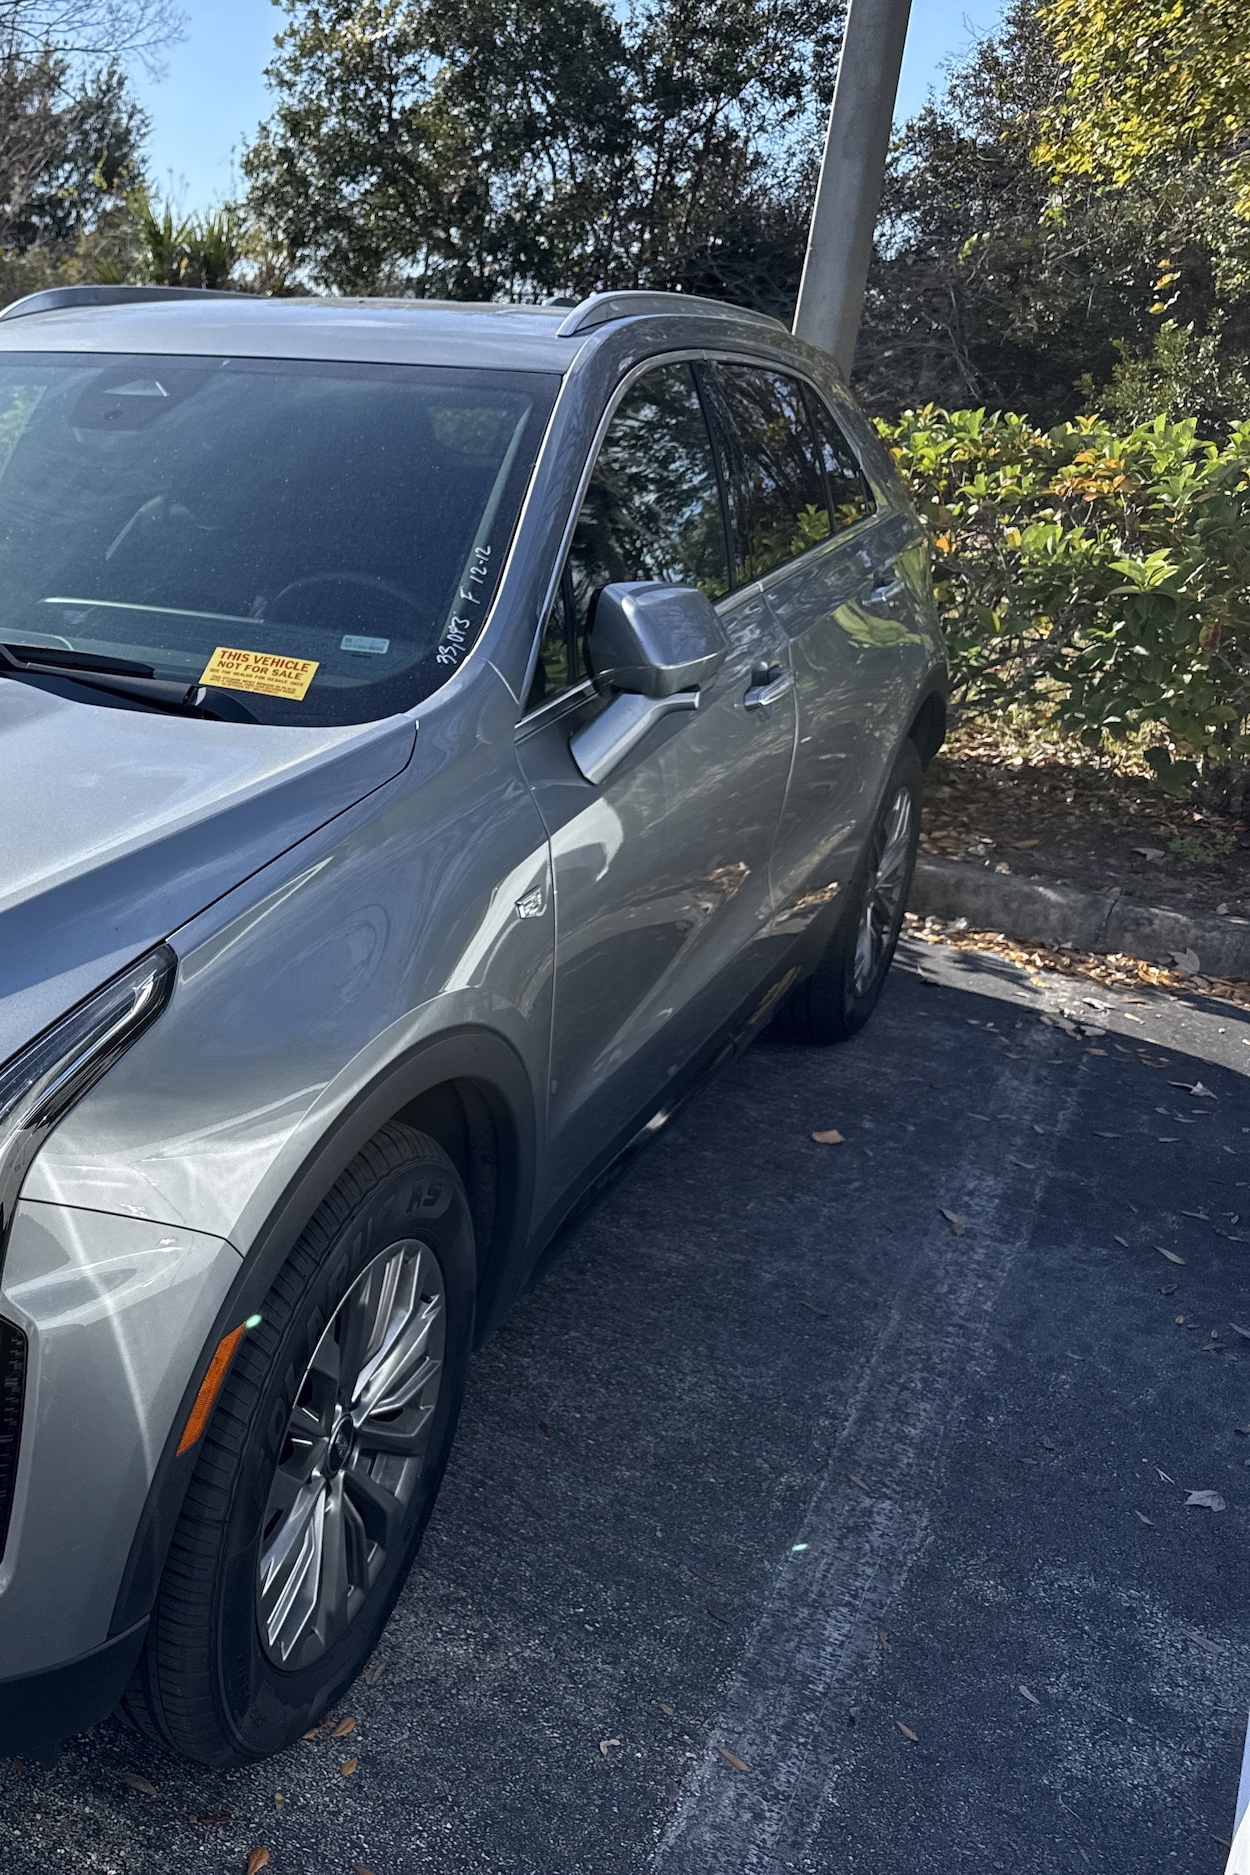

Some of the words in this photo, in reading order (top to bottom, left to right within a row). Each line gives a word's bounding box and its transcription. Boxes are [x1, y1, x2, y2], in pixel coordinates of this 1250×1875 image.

[470, 545, 492, 584] 12-12
[217, 661, 241, 670] NOT
[244, 664, 269, 675] FOR
[272, 669, 303, 680] SALE
[220, 650, 250, 662] THIS
[254, 655, 312, 672] VEHICLE
[232, 671, 253, 679] DEALER
